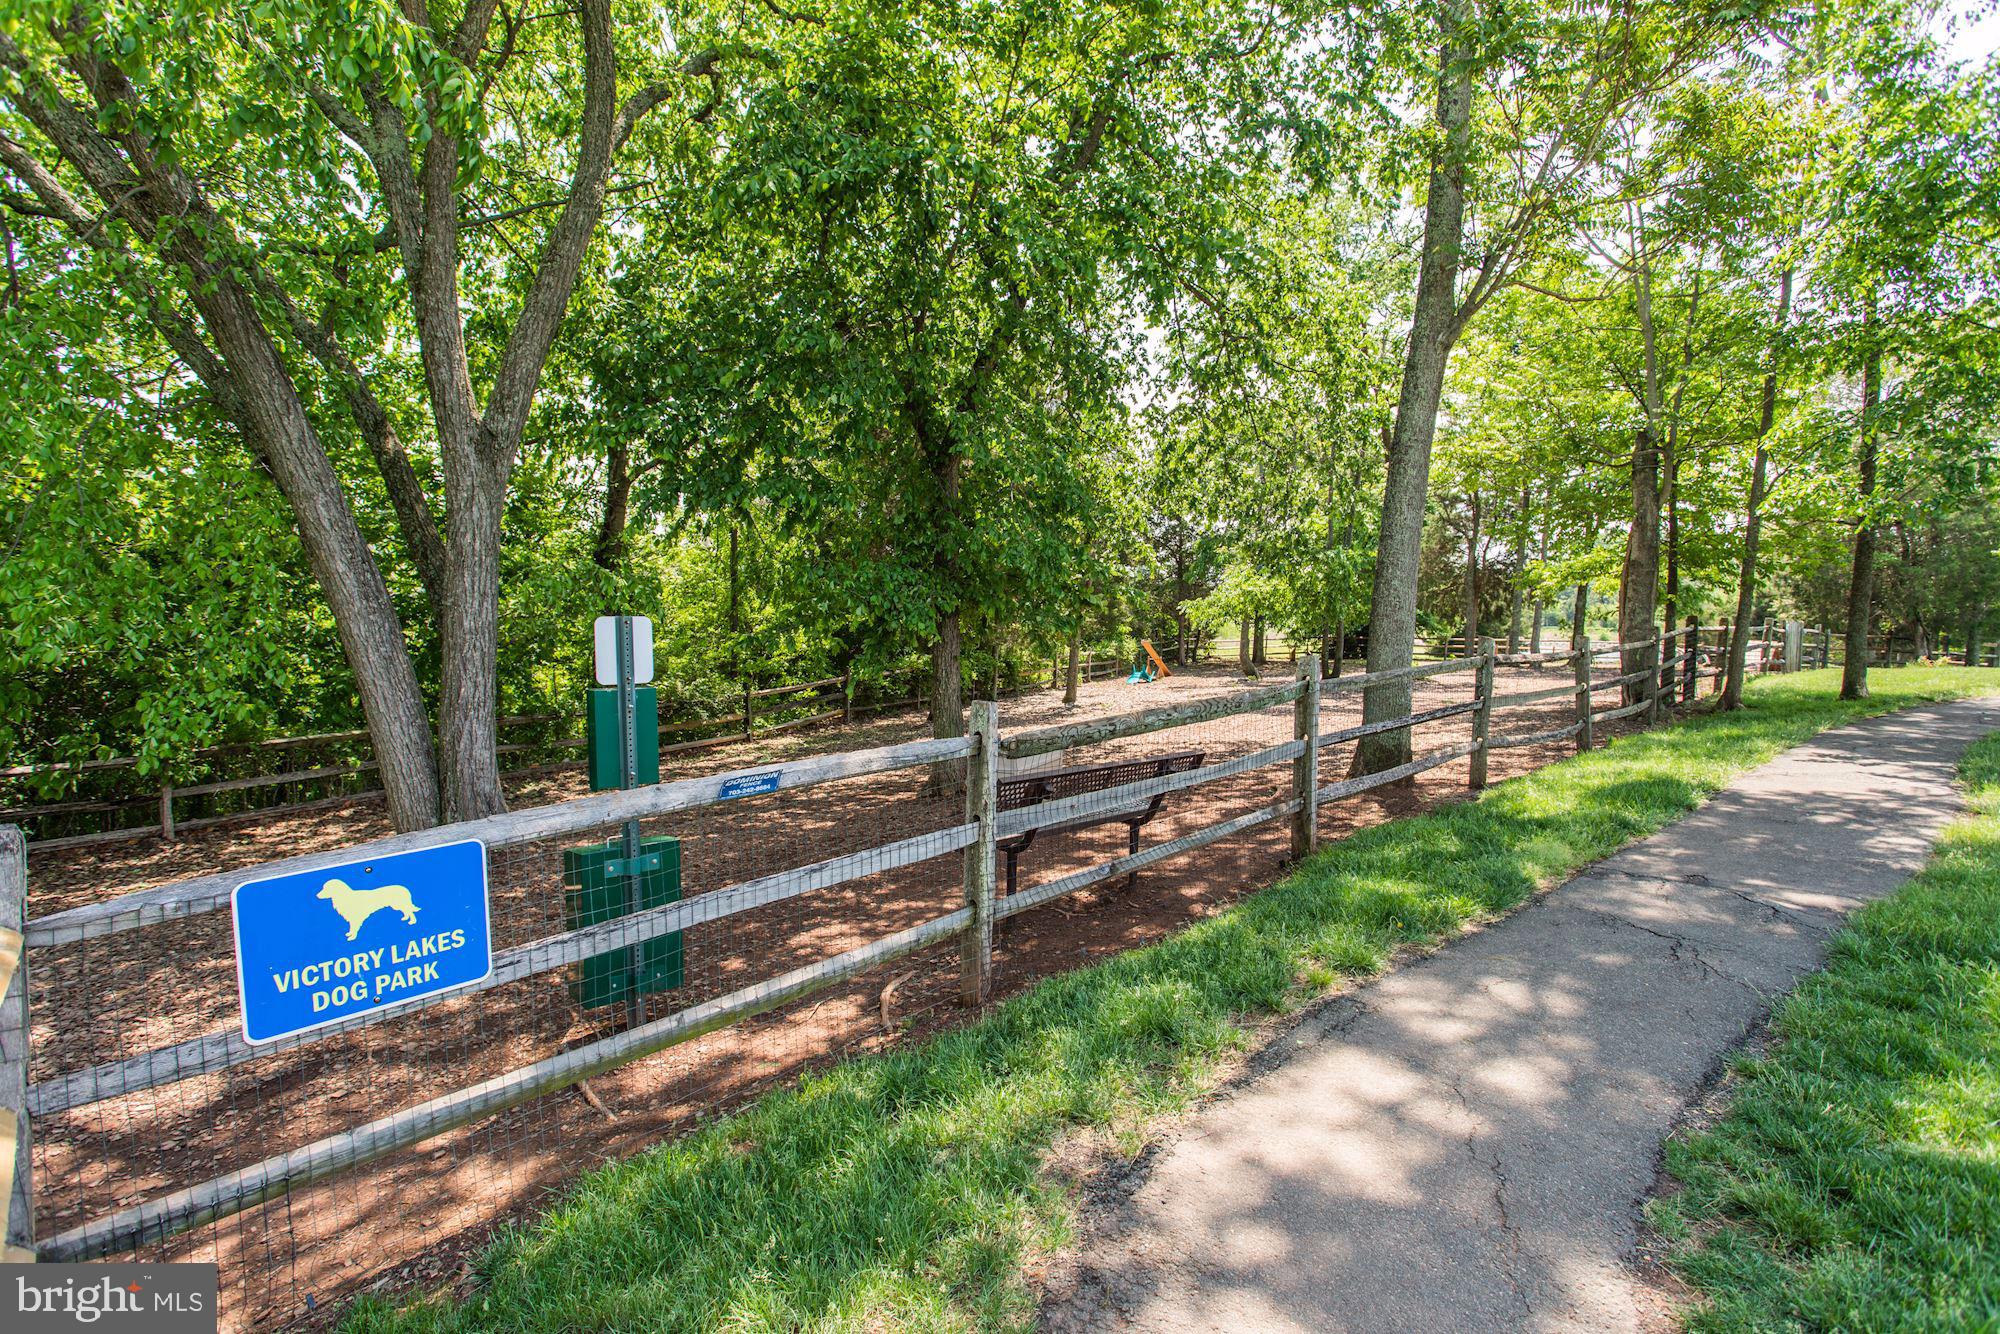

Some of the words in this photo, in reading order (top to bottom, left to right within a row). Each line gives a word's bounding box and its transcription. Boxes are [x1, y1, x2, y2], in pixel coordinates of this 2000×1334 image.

[725, 772, 779, 786] DOMINION
[740, 780, 762, 788] FENCE
[273, 948, 385, 993] VICTORY
[391, 929, 466, 964] LAKES
[312, 981, 367, 1013] DOG
[375, 961, 440, 995] PARK
